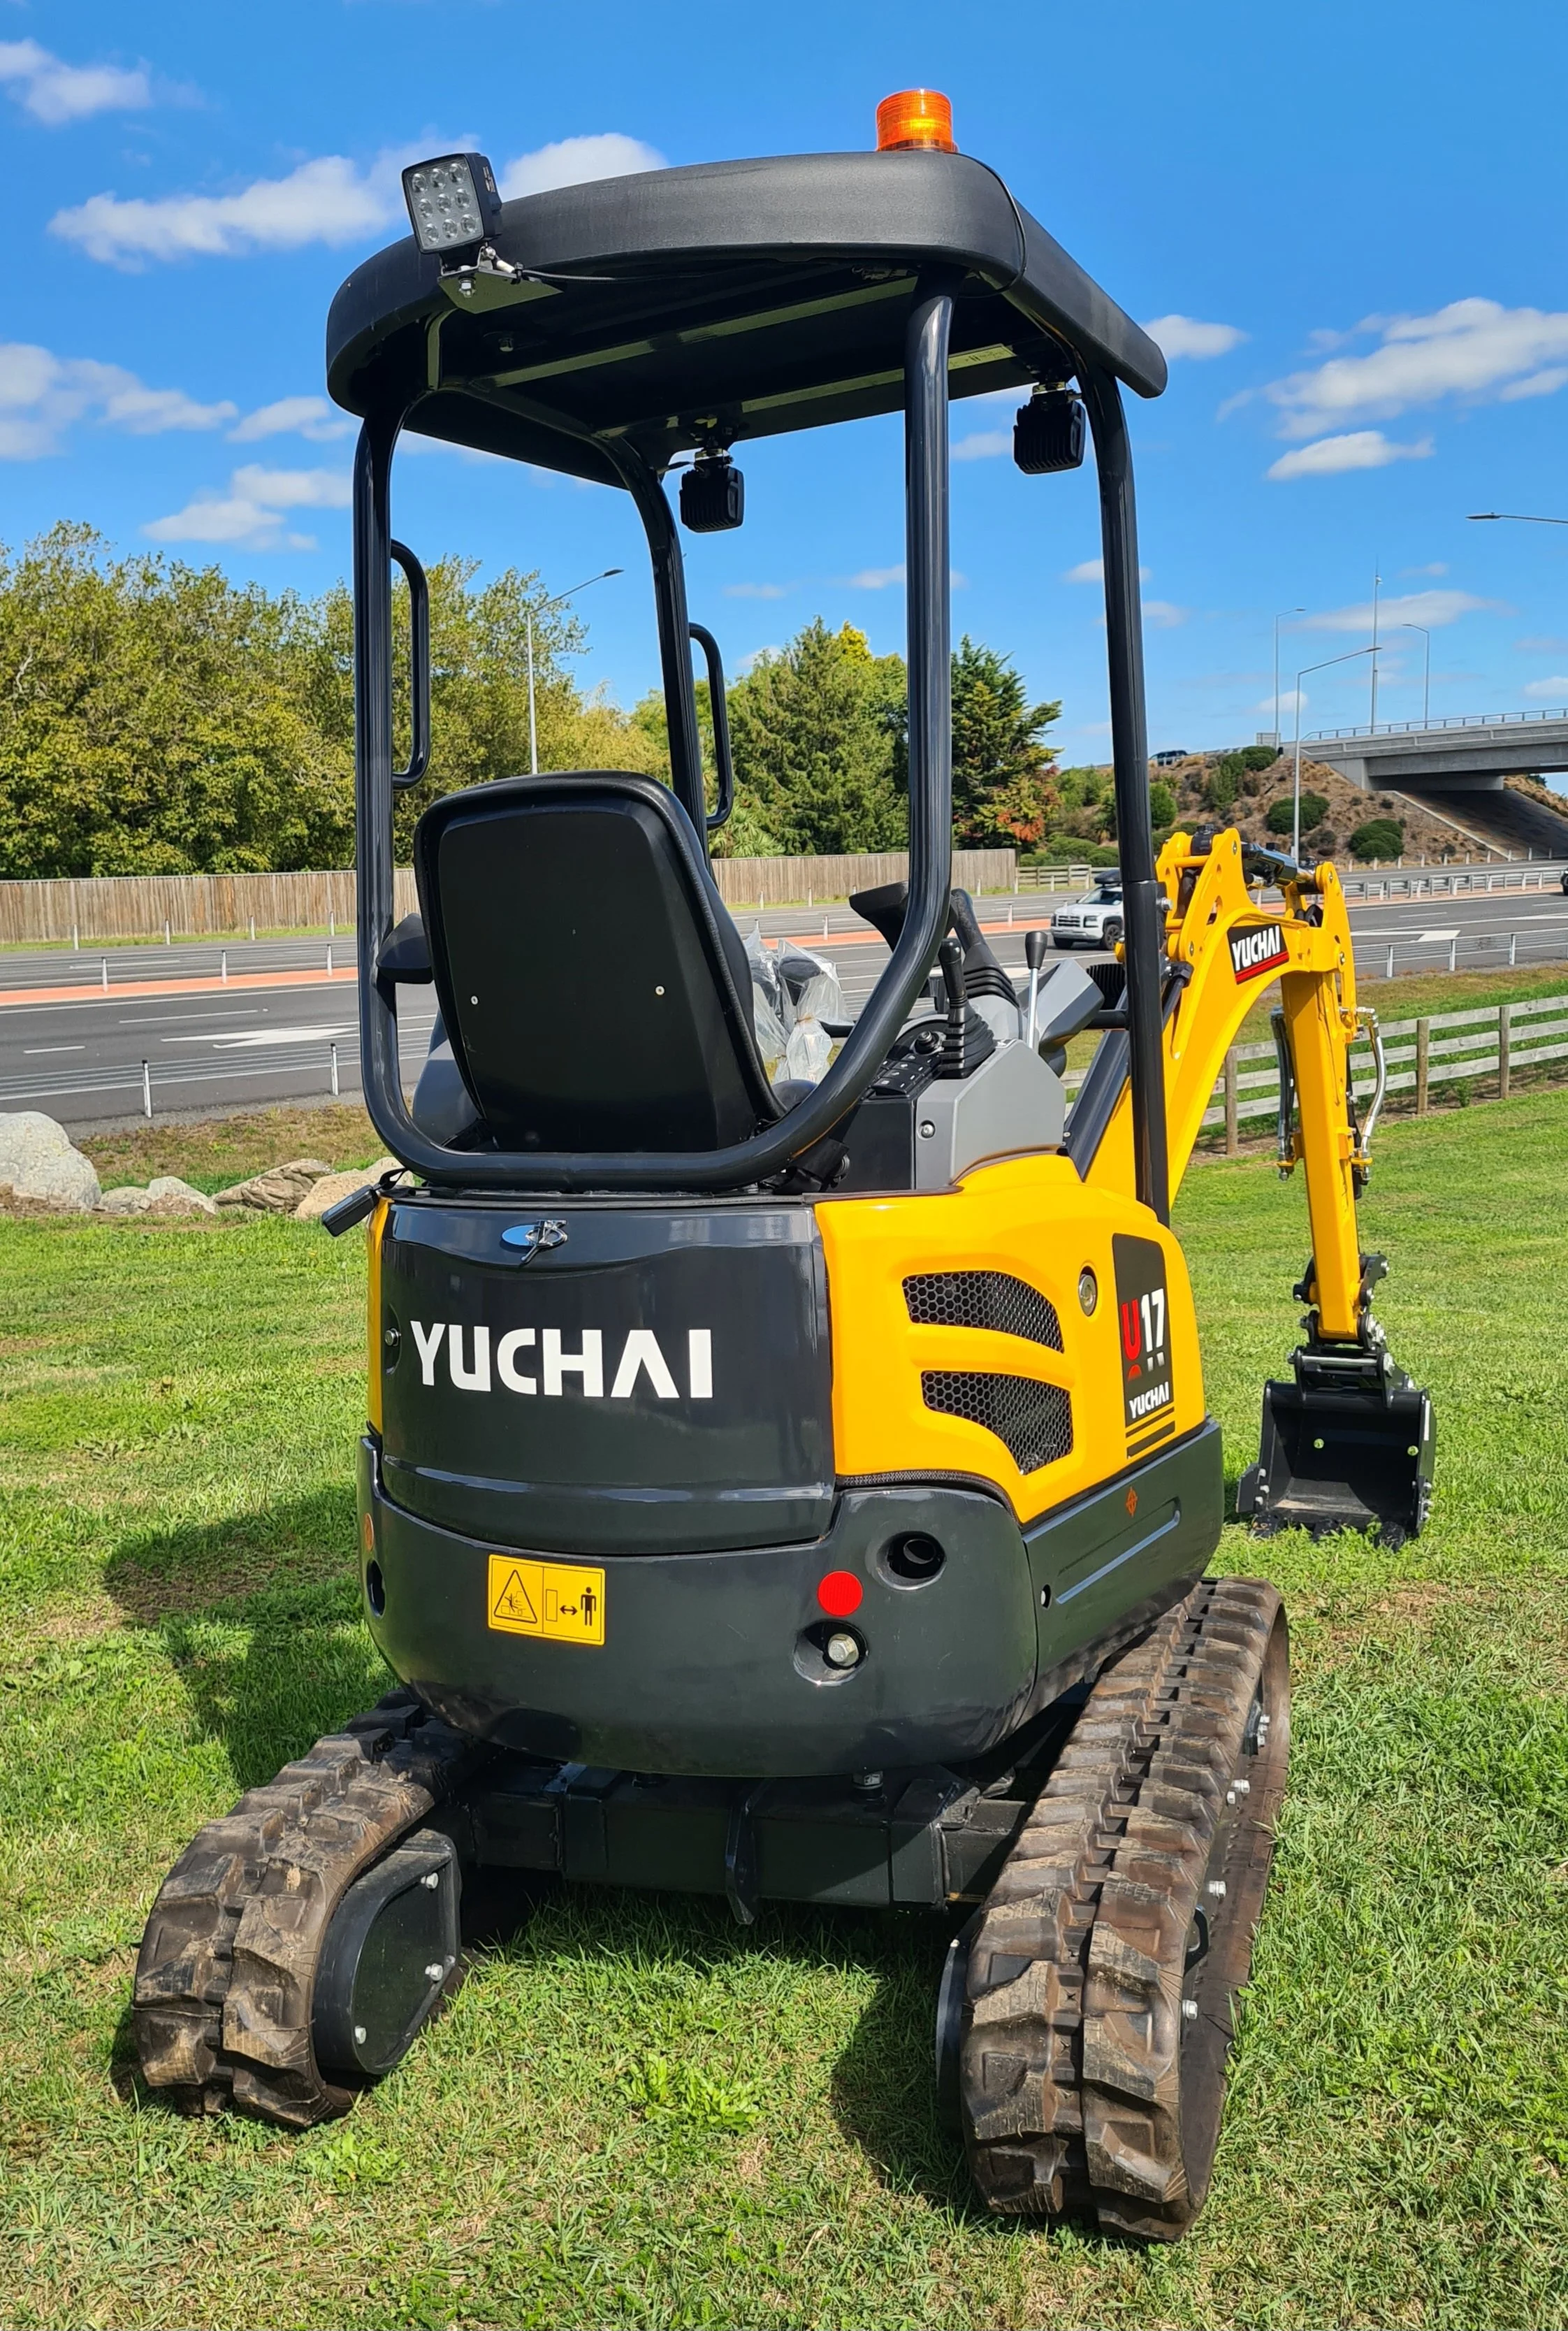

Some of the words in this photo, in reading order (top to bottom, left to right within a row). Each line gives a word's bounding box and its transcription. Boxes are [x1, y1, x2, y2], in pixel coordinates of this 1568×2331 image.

[1231, 925, 1281, 972] YUCHAI
[1121, 1288, 1165, 1362] U17
[409, 1320, 713, 1399] YUCHAI
[1128, 1381, 1170, 1419] YUCHAI
